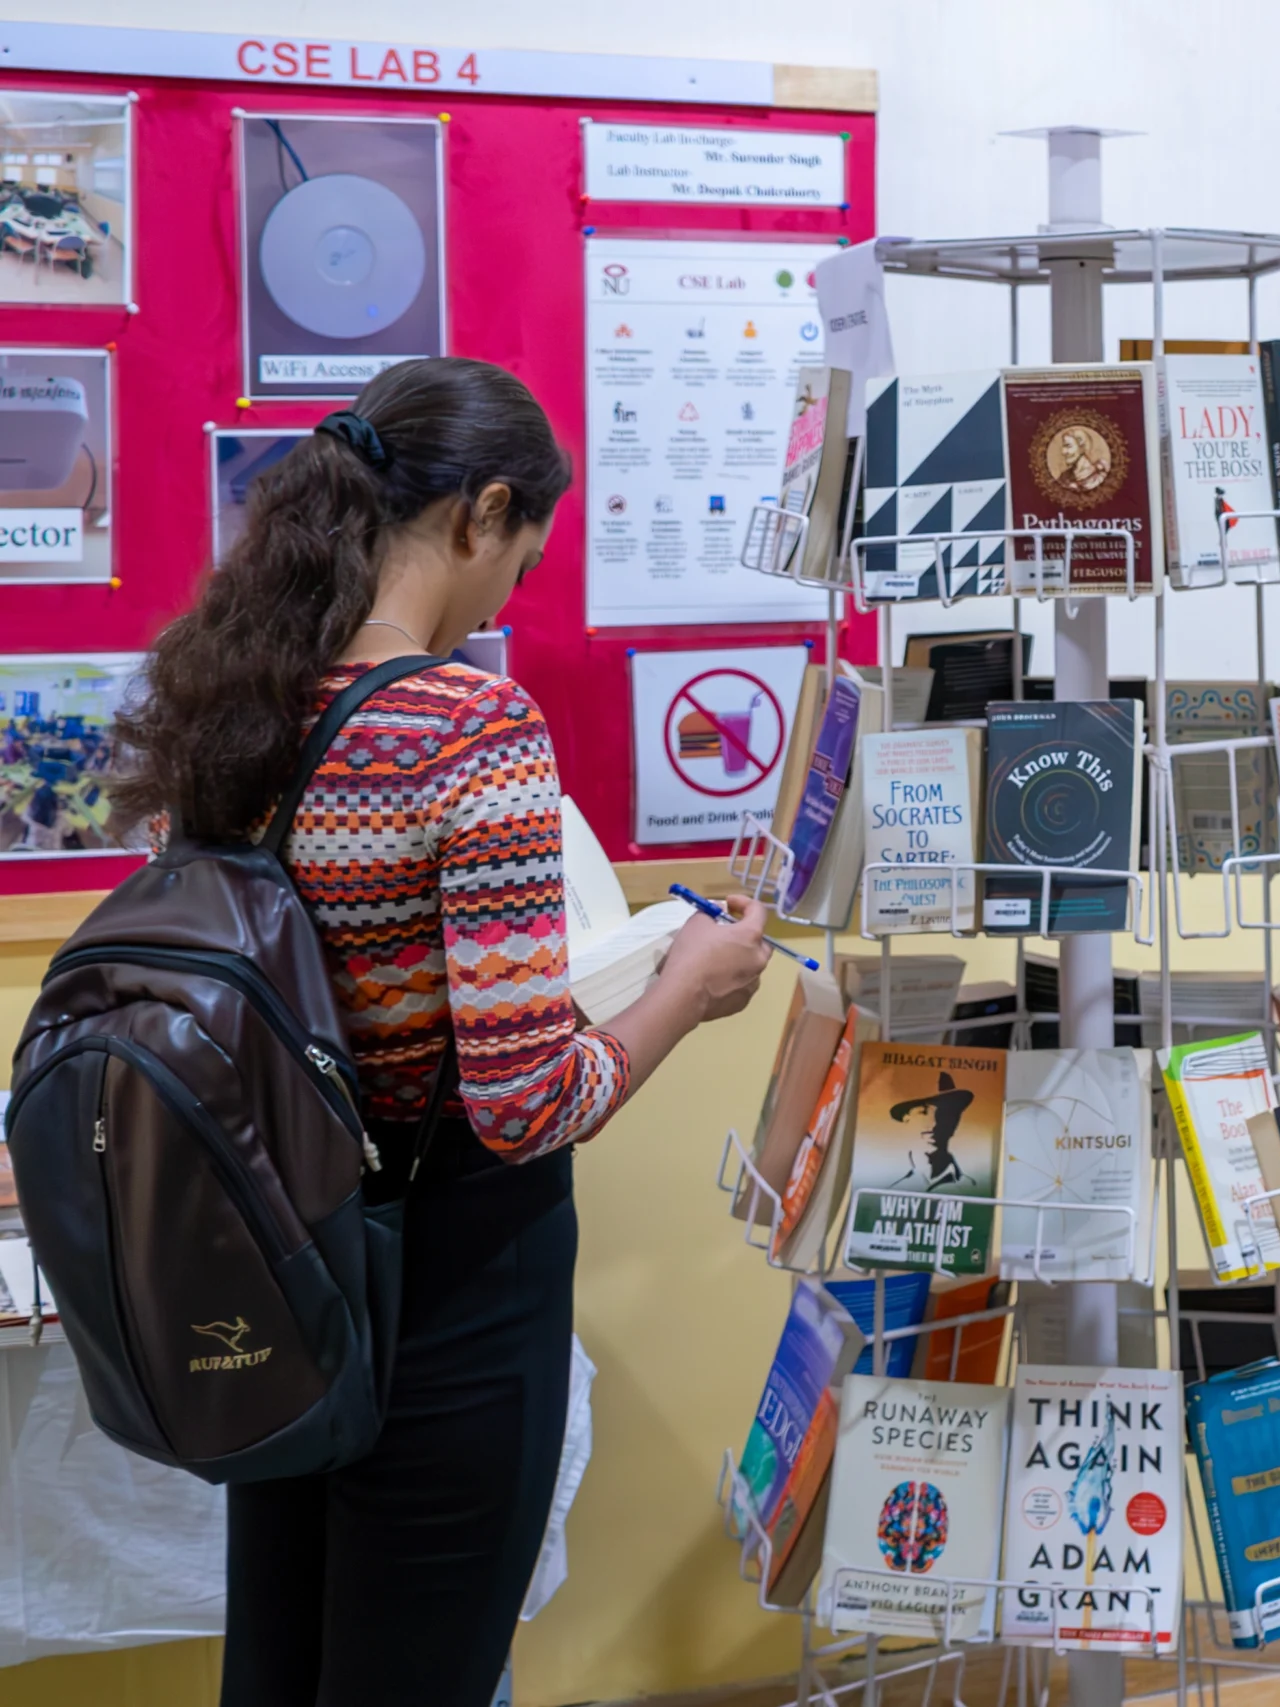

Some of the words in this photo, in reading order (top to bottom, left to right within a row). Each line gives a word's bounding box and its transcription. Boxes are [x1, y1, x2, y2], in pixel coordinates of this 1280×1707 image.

[237, 40, 332, 79] CSE
[350, 46, 441, 85] LAB
[457, 52, 481, 86] 4
[606, 129, 649, 145] Faculty
[653, 131, 676, 143] Lab
[607, 164, 630, 177] Lab
[789, 154, 822, 168] Singh
[697, 183, 743, 197] Deepak
[677, 275, 712, 290] CSE
[717, 276, 745, 290] Lab
[263, 359, 307, 377] WiFi
[315, 361, 374, 377] Access
[1178, 405, 1262, 443] LADY,
[1193, 441, 1251, 459] YOU'RE
[1184, 461, 1217, 479] THE
[1221, 460, 1263, 478] BOSS!
[1007, 751, 1069, 789] Know
[1076, 750, 1114, 792] This
[890, 780, 943, 805] FROM
[647, 812, 679, 828] Food
[682, 812, 704, 826] and
[708, 811, 738, 824] Drink
[872, 803, 963, 829] SOCRATES
[906, 829, 929, 849] TO
[874, 879, 892, 892] THE
[882, 1053, 945, 1069] BHAGAT
[949, 1057, 998, 1072] SINGH
[1217, 1098, 1244, 1118] The
[1219, 1121, 1249, 1140] Boo
[1055, 1135, 1132, 1150] KINTSUGI
[1230, 1181, 1257, 1202] Alan
[881, 1195, 921, 1219] WHY
[924, 1198, 931, 1220] I
[903, 1221, 973, 1248] ATHIST
[863, 1400, 988, 1429] RUNAWAY
[1028, 1397, 1163, 1431] THINK
[872, 1425, 974, 1453] SPECIES
[1025, 1440, 1162, 1474] AGAIN
[1029, 1542, 1152, 1574] ADAM
[844, 1579, 909, 1596] ANTHONY
